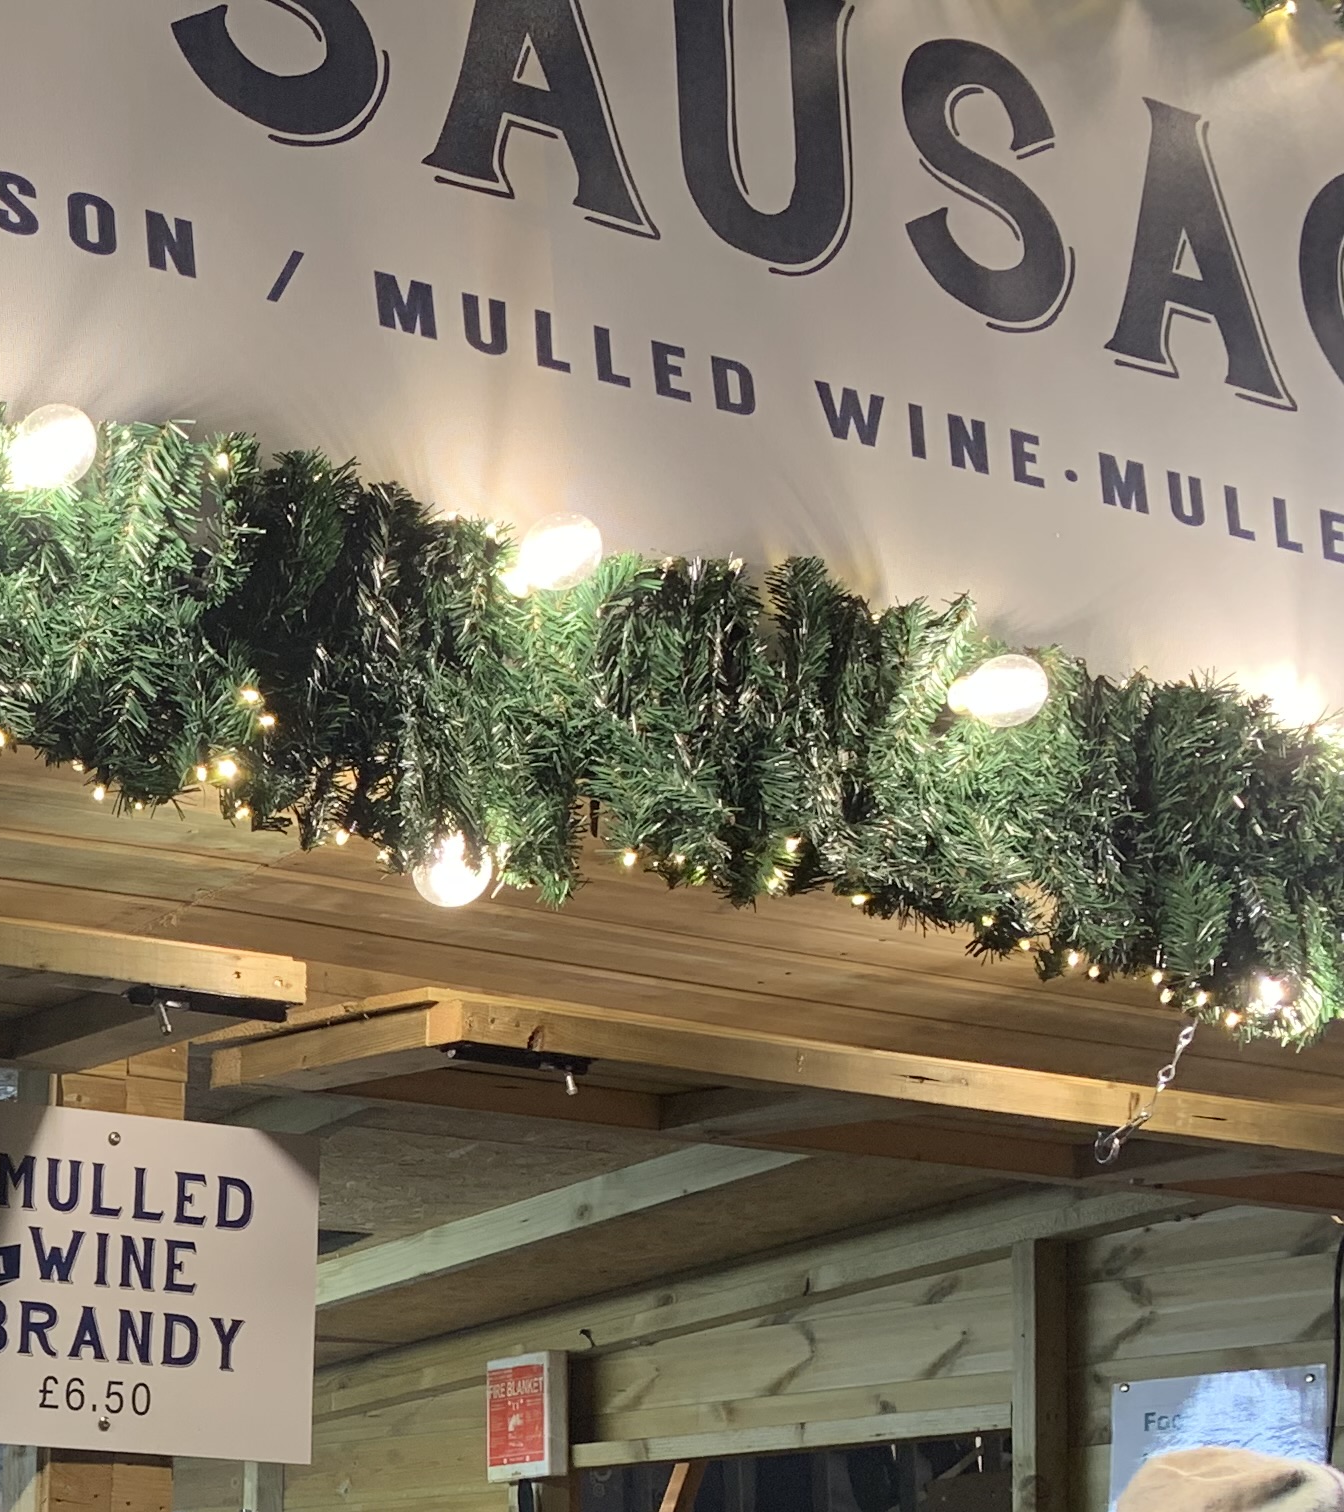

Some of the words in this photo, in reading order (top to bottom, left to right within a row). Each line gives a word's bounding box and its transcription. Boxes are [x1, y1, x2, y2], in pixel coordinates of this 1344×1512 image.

[374, 271, 756, 416] MULLED
[28, 1226, 198, 1295] WINE
[38, 1375, 152, 1417] £6.50
[489, 1383, 506, 1399] FIRE
[506, 1377, 544, 1397] BLANKET
